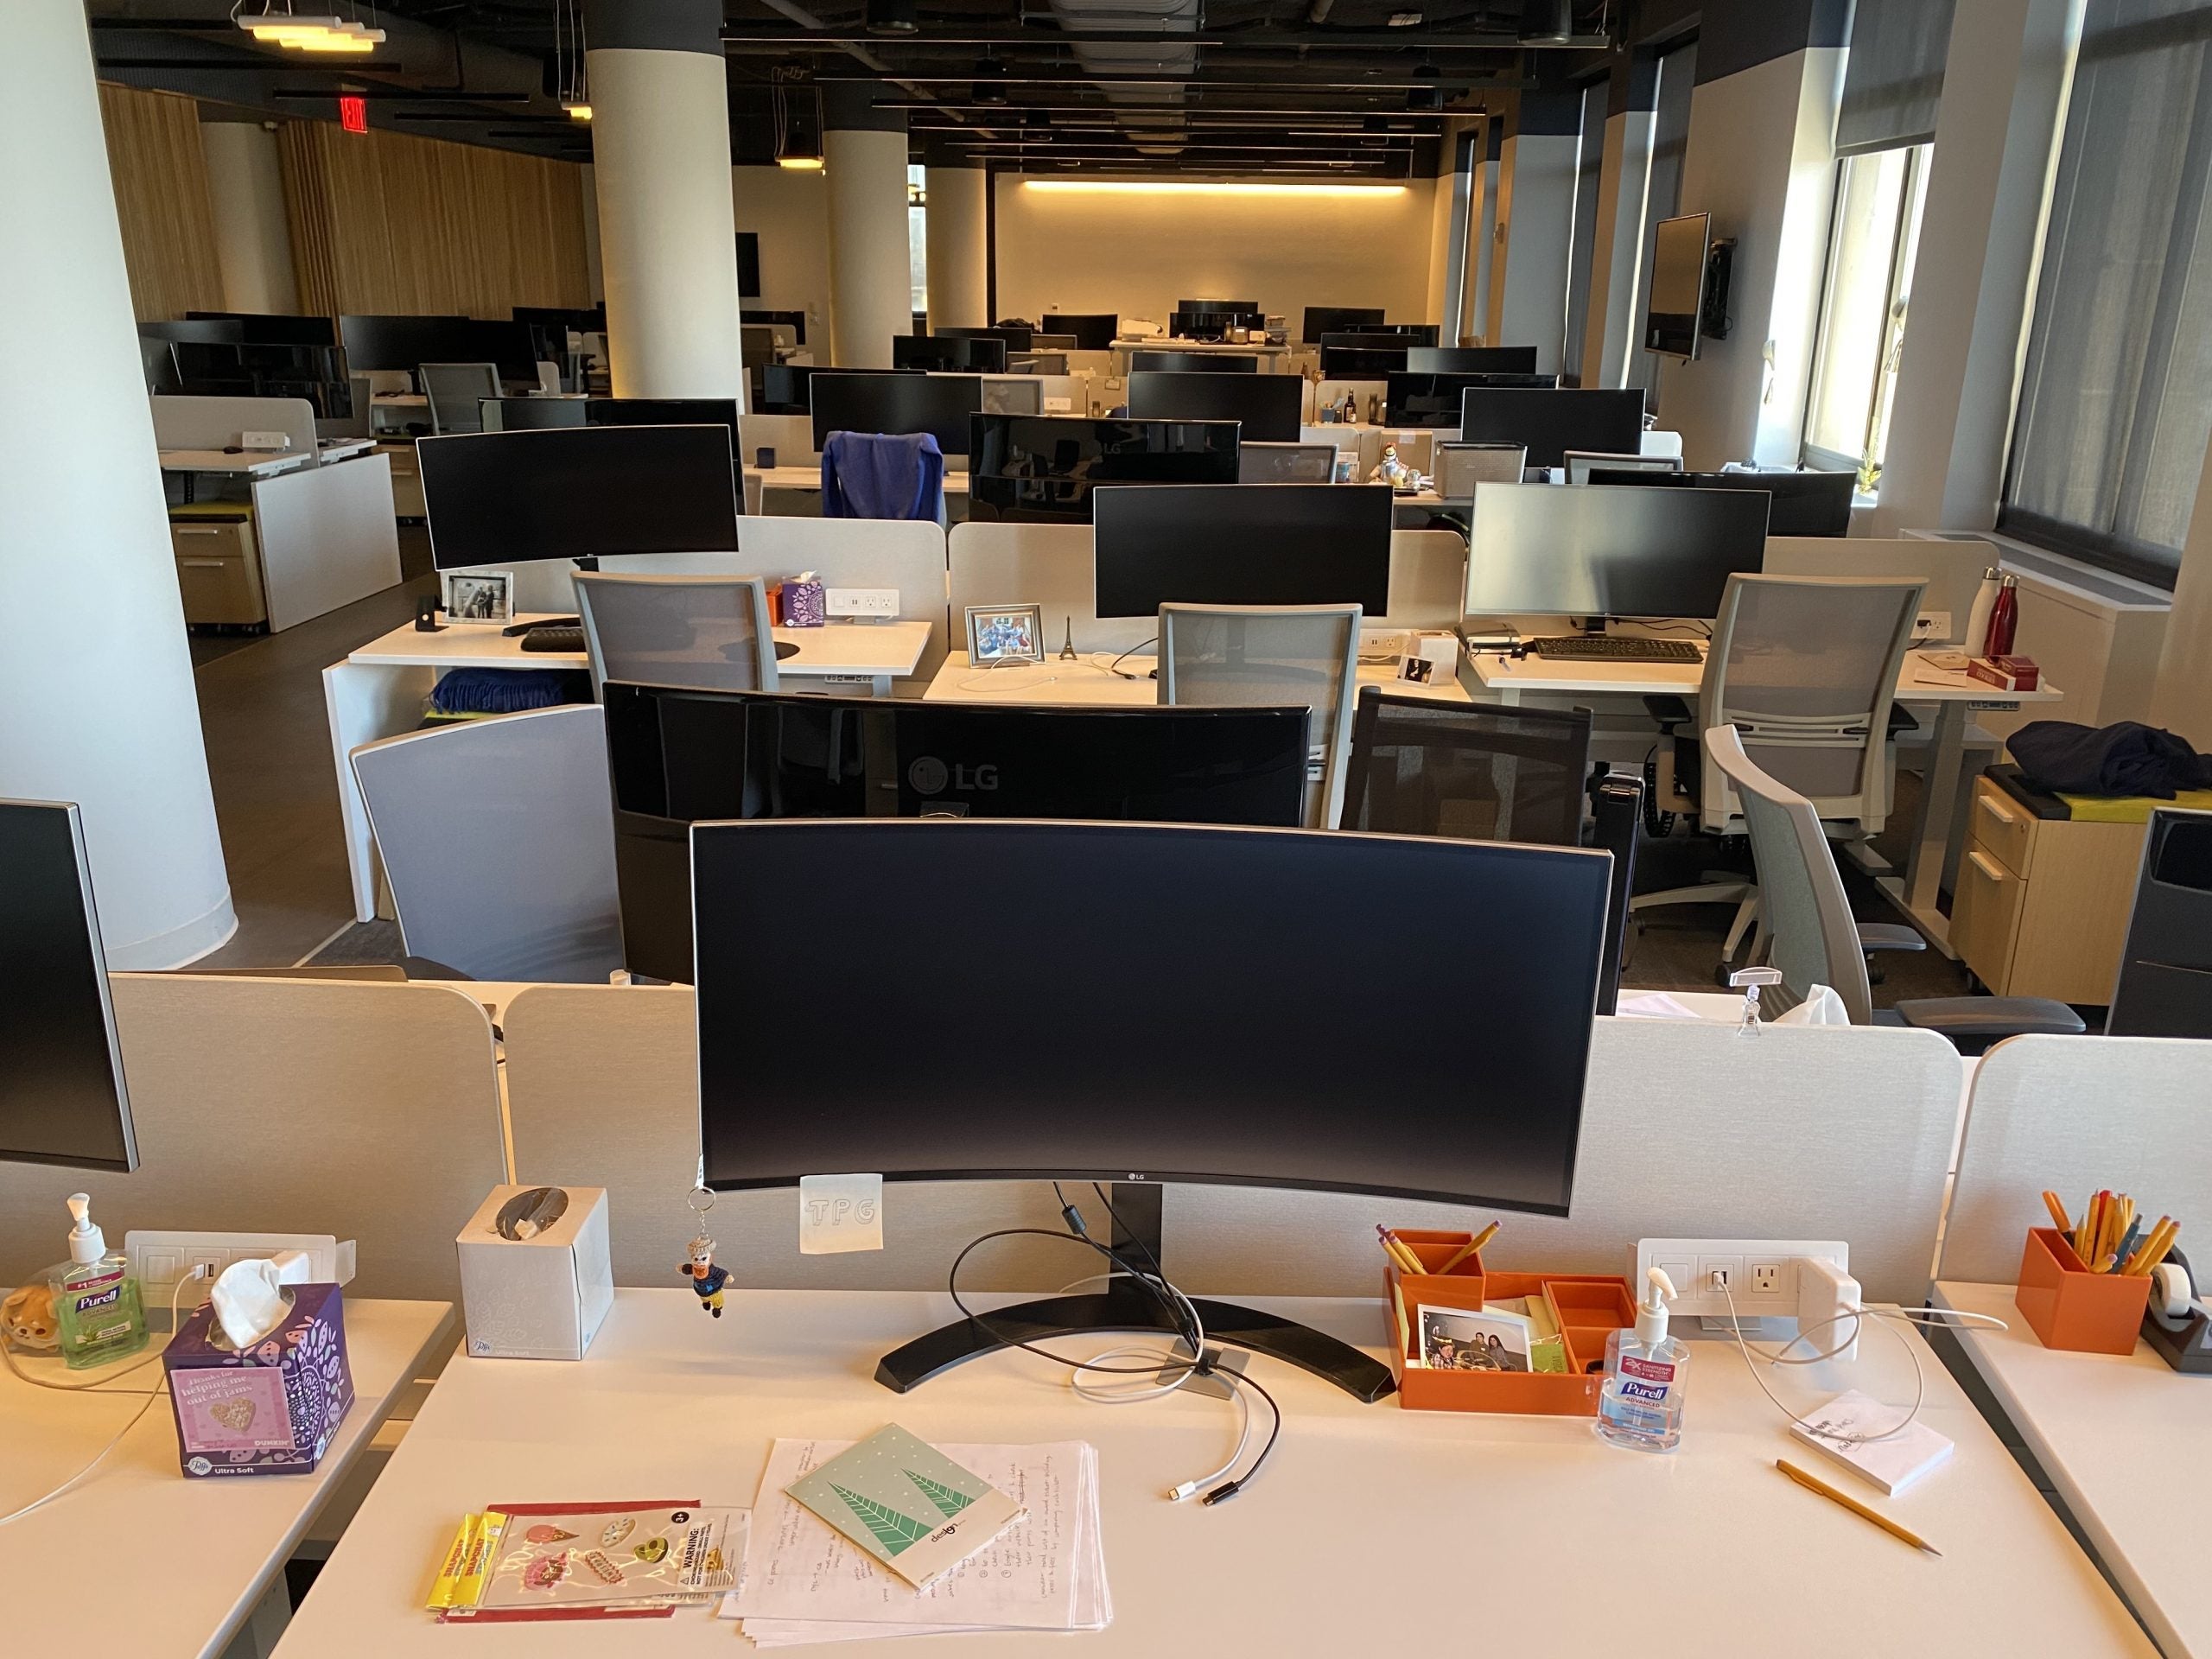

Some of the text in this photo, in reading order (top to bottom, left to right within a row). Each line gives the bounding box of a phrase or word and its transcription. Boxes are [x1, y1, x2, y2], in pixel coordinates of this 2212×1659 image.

[345, 98, 364, 130] EXIT
[1104, 442, 1122, 454] LG
[954, 763, 1000, 791] LG
[804, 1198, 875, 1226] TPG
[80, 1289, 118, 1310] Purell
[476, 1340, 491, 1352] Puffs
[1624, 1357, 1643, 1371] 2X
[1642, 1363, 1672, 1372] SANITIZING
[180, 1375, 248, 1398] helping me
[188, 1370, 234, 1385] Thanks for
[187, 1384, 253, 1406] out of jams
[1627, 1382, 1664, 1400] Purell
[1625, 1396, 1661, 1408] ADVANCED
[191, 1459, 209, 1472] Puffs
[675, 1513, 684, 1522] 3+
[931, 1522, 958, 1542] design
[464, 1537, 485, 1577] SNAPCHAT
[683, 1528, 700, 1568] WARNING:
[442, 1539, 465, 1578] SNAPCHAT
